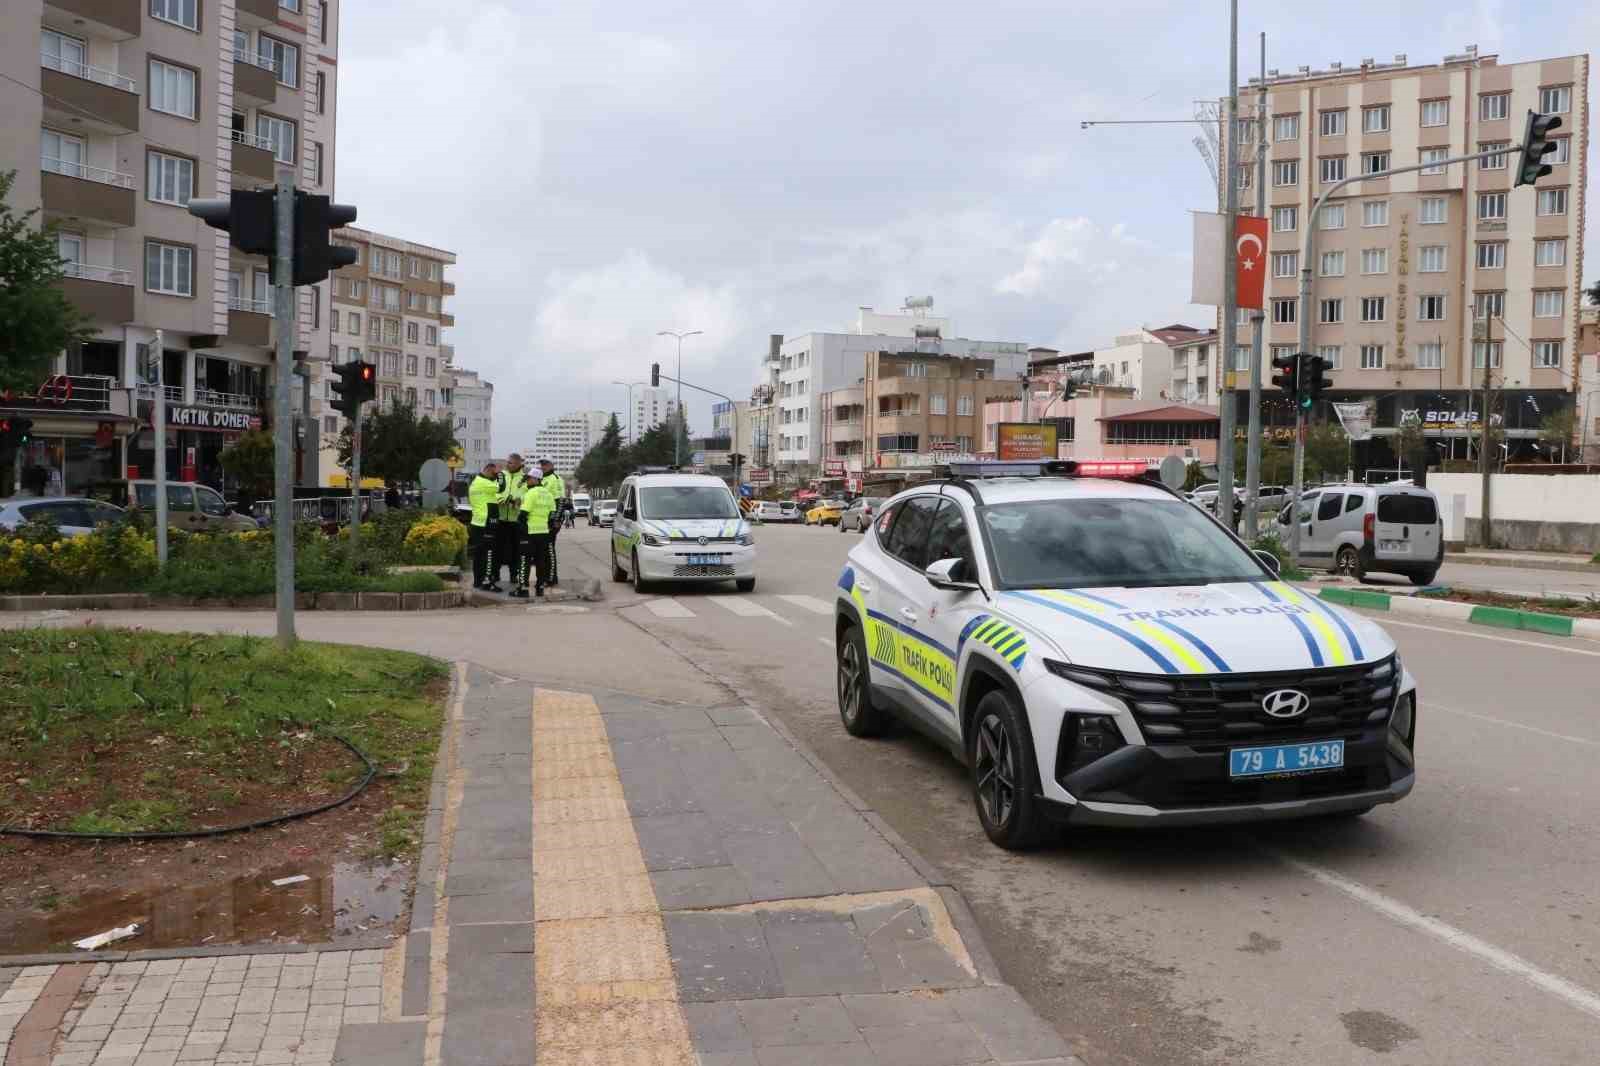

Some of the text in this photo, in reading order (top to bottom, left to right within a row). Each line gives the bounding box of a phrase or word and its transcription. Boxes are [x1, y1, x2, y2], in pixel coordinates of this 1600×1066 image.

[902, 645, 928, 677] TRAFİK
[1241, 744, 1340, 773] 79 A 5438
